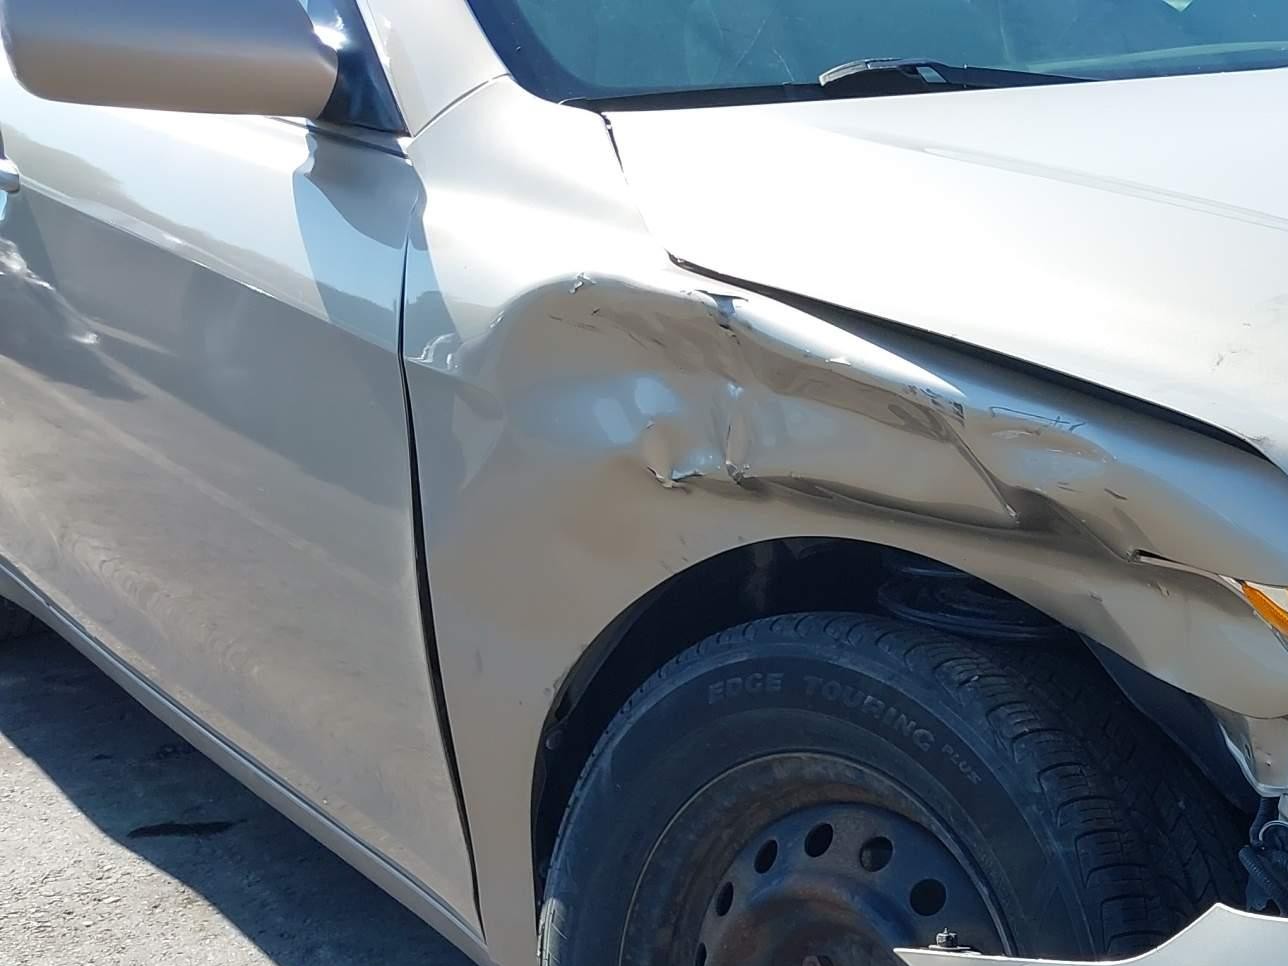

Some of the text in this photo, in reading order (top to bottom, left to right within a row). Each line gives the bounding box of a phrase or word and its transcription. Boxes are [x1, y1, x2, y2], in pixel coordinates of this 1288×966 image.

[708, 672, 983, 786] EDGE TOURING PLUS
